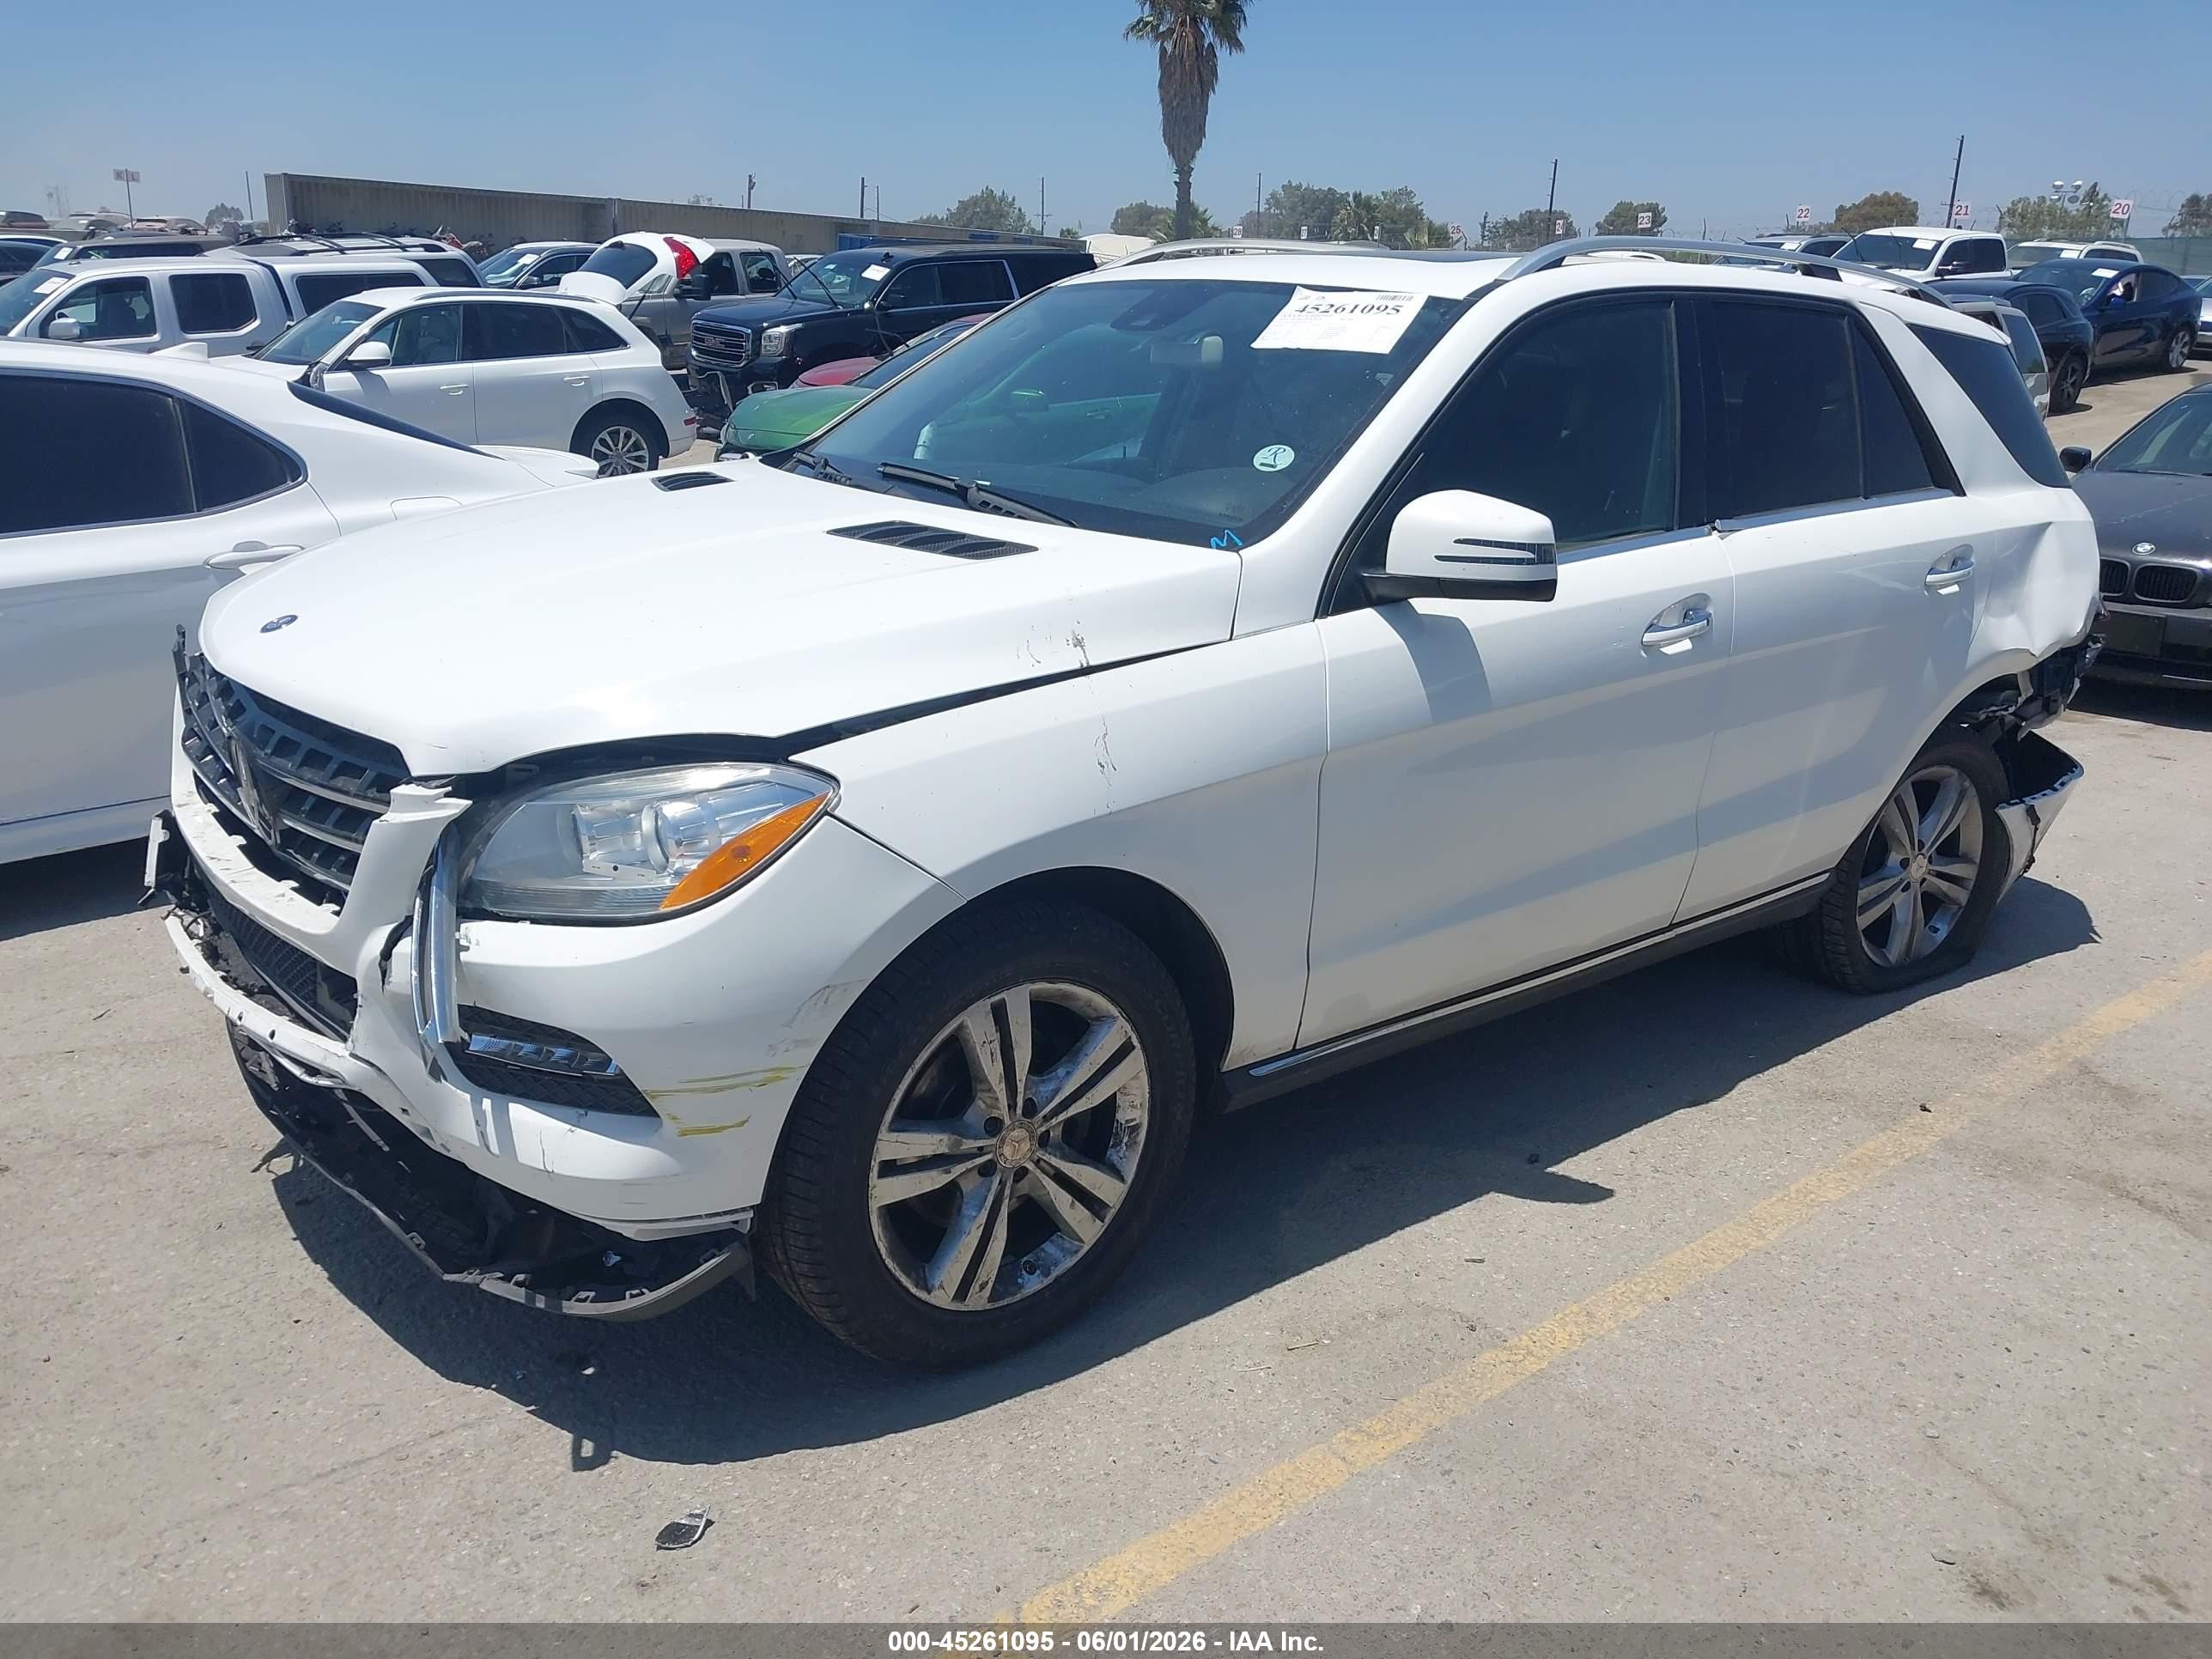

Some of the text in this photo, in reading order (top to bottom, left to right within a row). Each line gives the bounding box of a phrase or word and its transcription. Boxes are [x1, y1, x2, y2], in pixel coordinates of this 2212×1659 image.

[1796, 207, 1810, 219] 22
[1954, 204, 1970, 216] 21
[2112, 202, 2130, 216] 20
[1638, 215, 1650, 226] 23
[1294, 303, 1405, 315] 45261095
